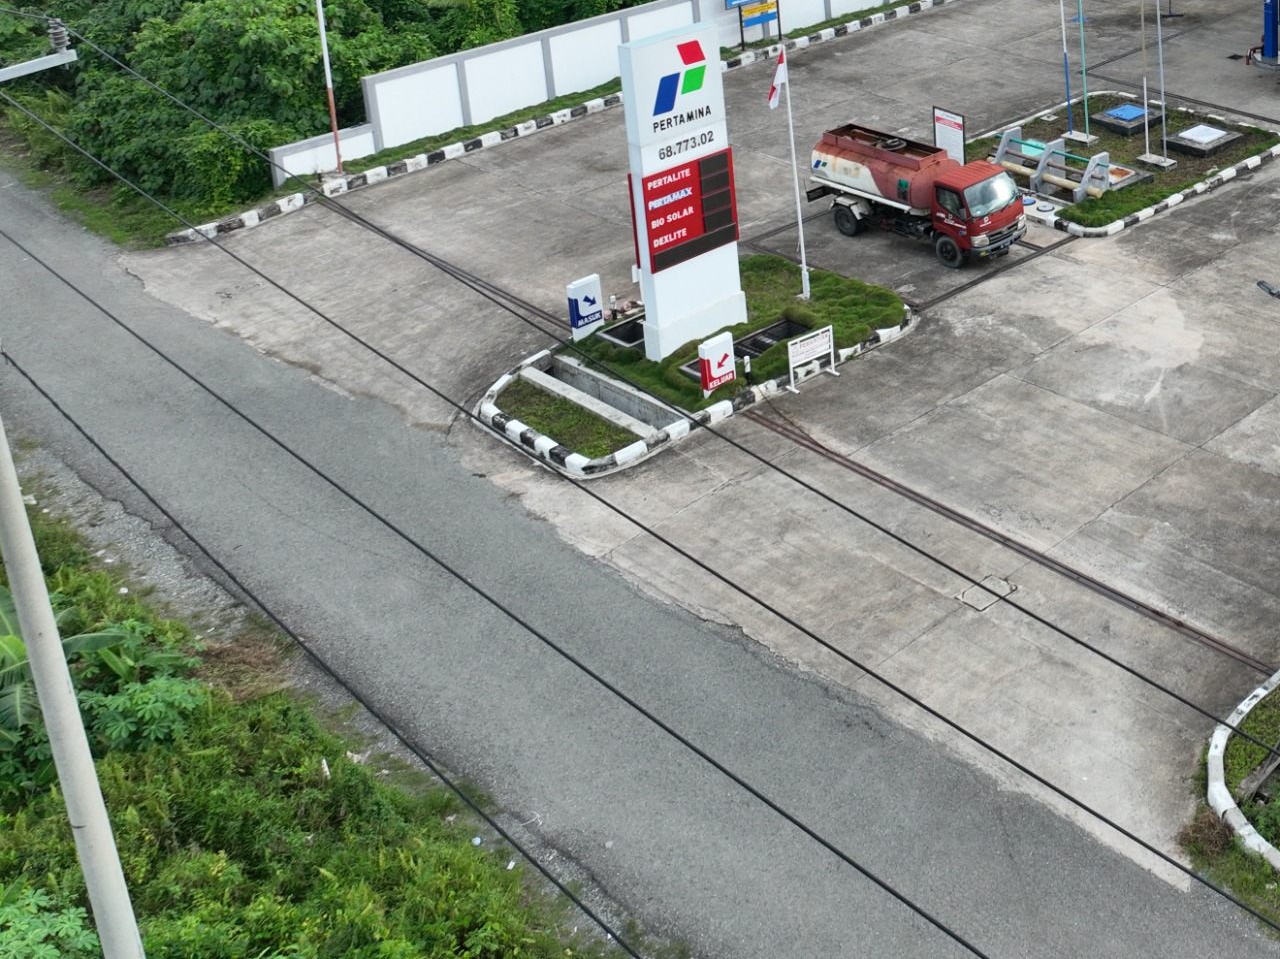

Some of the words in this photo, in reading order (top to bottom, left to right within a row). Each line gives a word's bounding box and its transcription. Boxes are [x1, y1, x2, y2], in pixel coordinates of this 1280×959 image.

[653, 105, 712, 133] PERTAMINA
[658, 130, 714, 160] 68.773.02
[647, 168, 691, 190] PERTALITE
[648, 187, 692, 210] PERTAMAX
[651, 218, 665, 230] BIO
[666, 206, 694, 223] SOLAR
[653, 228, 687, 248] DEXLITE
[577, 311, 602, 327] MASUK
[799, 332, 829, 350] PERHATIAN
[709, 372, 734, 389] KELUAR
